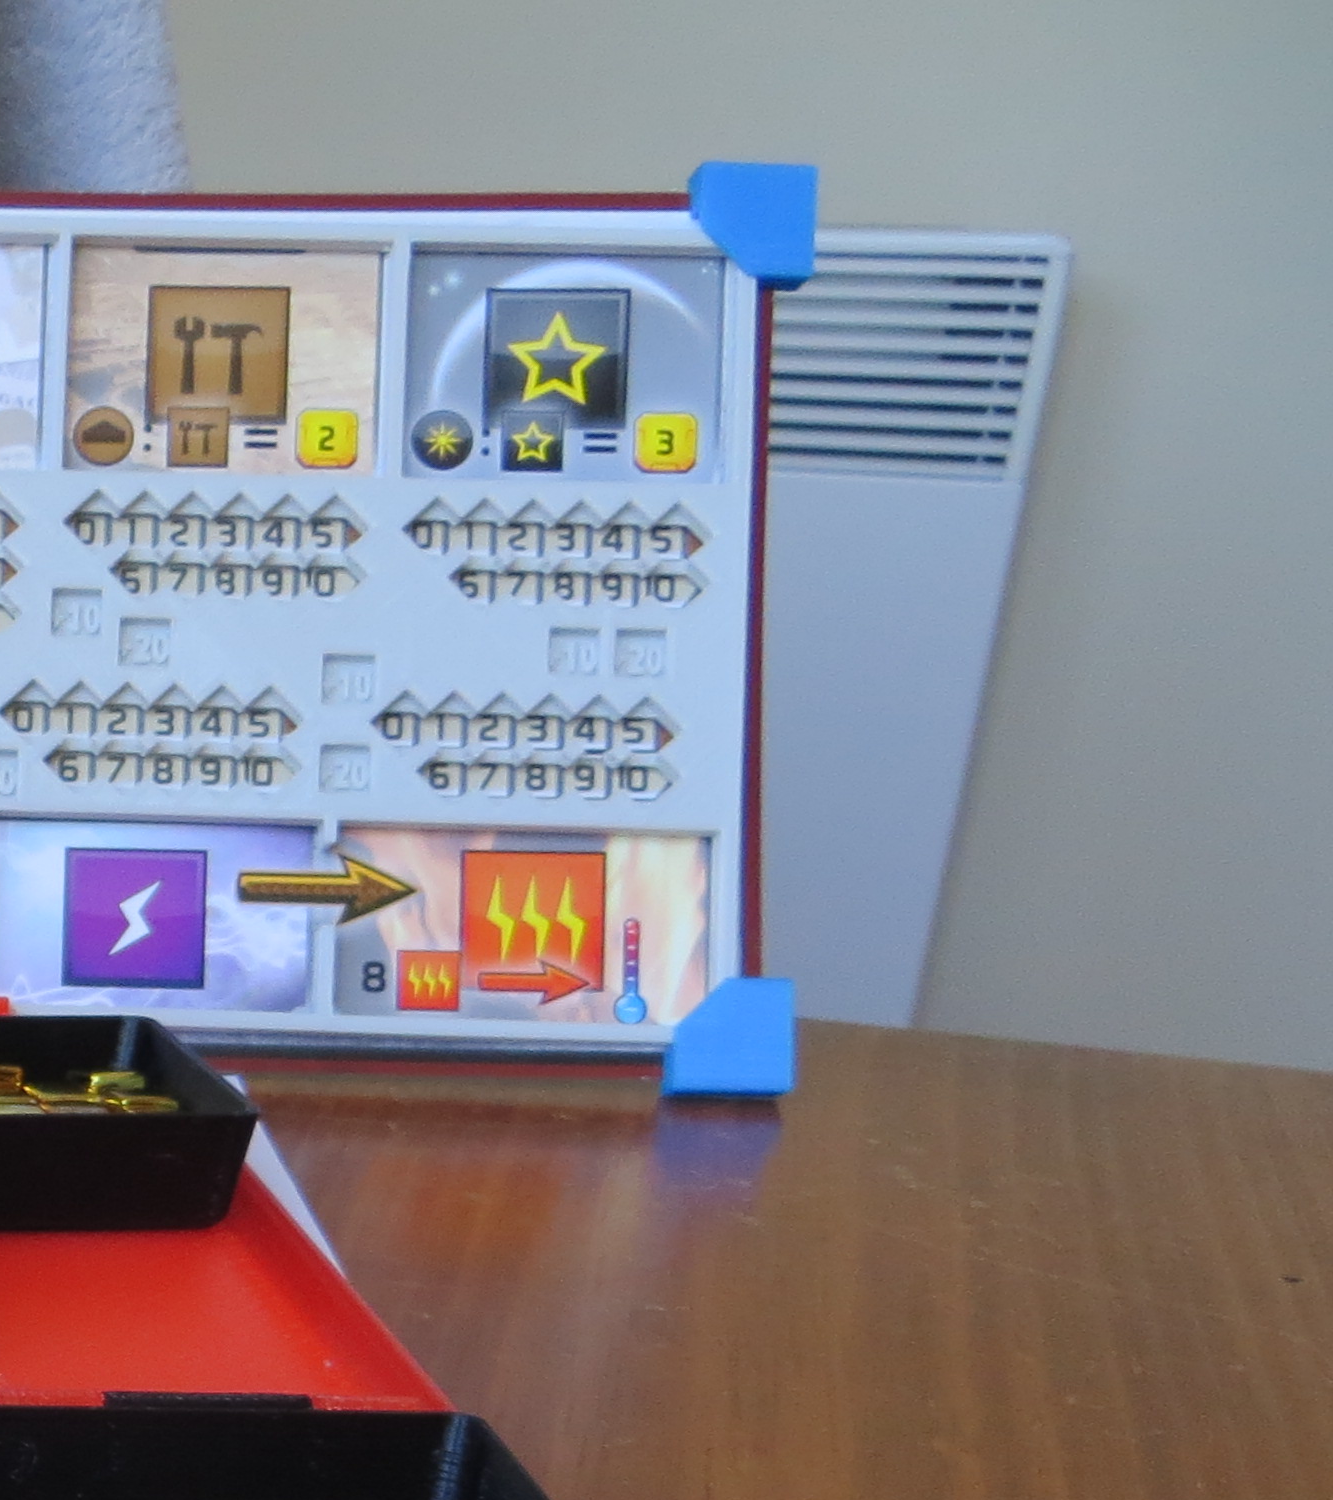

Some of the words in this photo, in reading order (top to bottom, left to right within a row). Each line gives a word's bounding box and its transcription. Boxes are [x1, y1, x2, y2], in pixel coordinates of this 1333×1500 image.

[317, 425, 336, 452] 2
[655, 429, 675, 456] 3
[362, 961, 385, 992] 8
